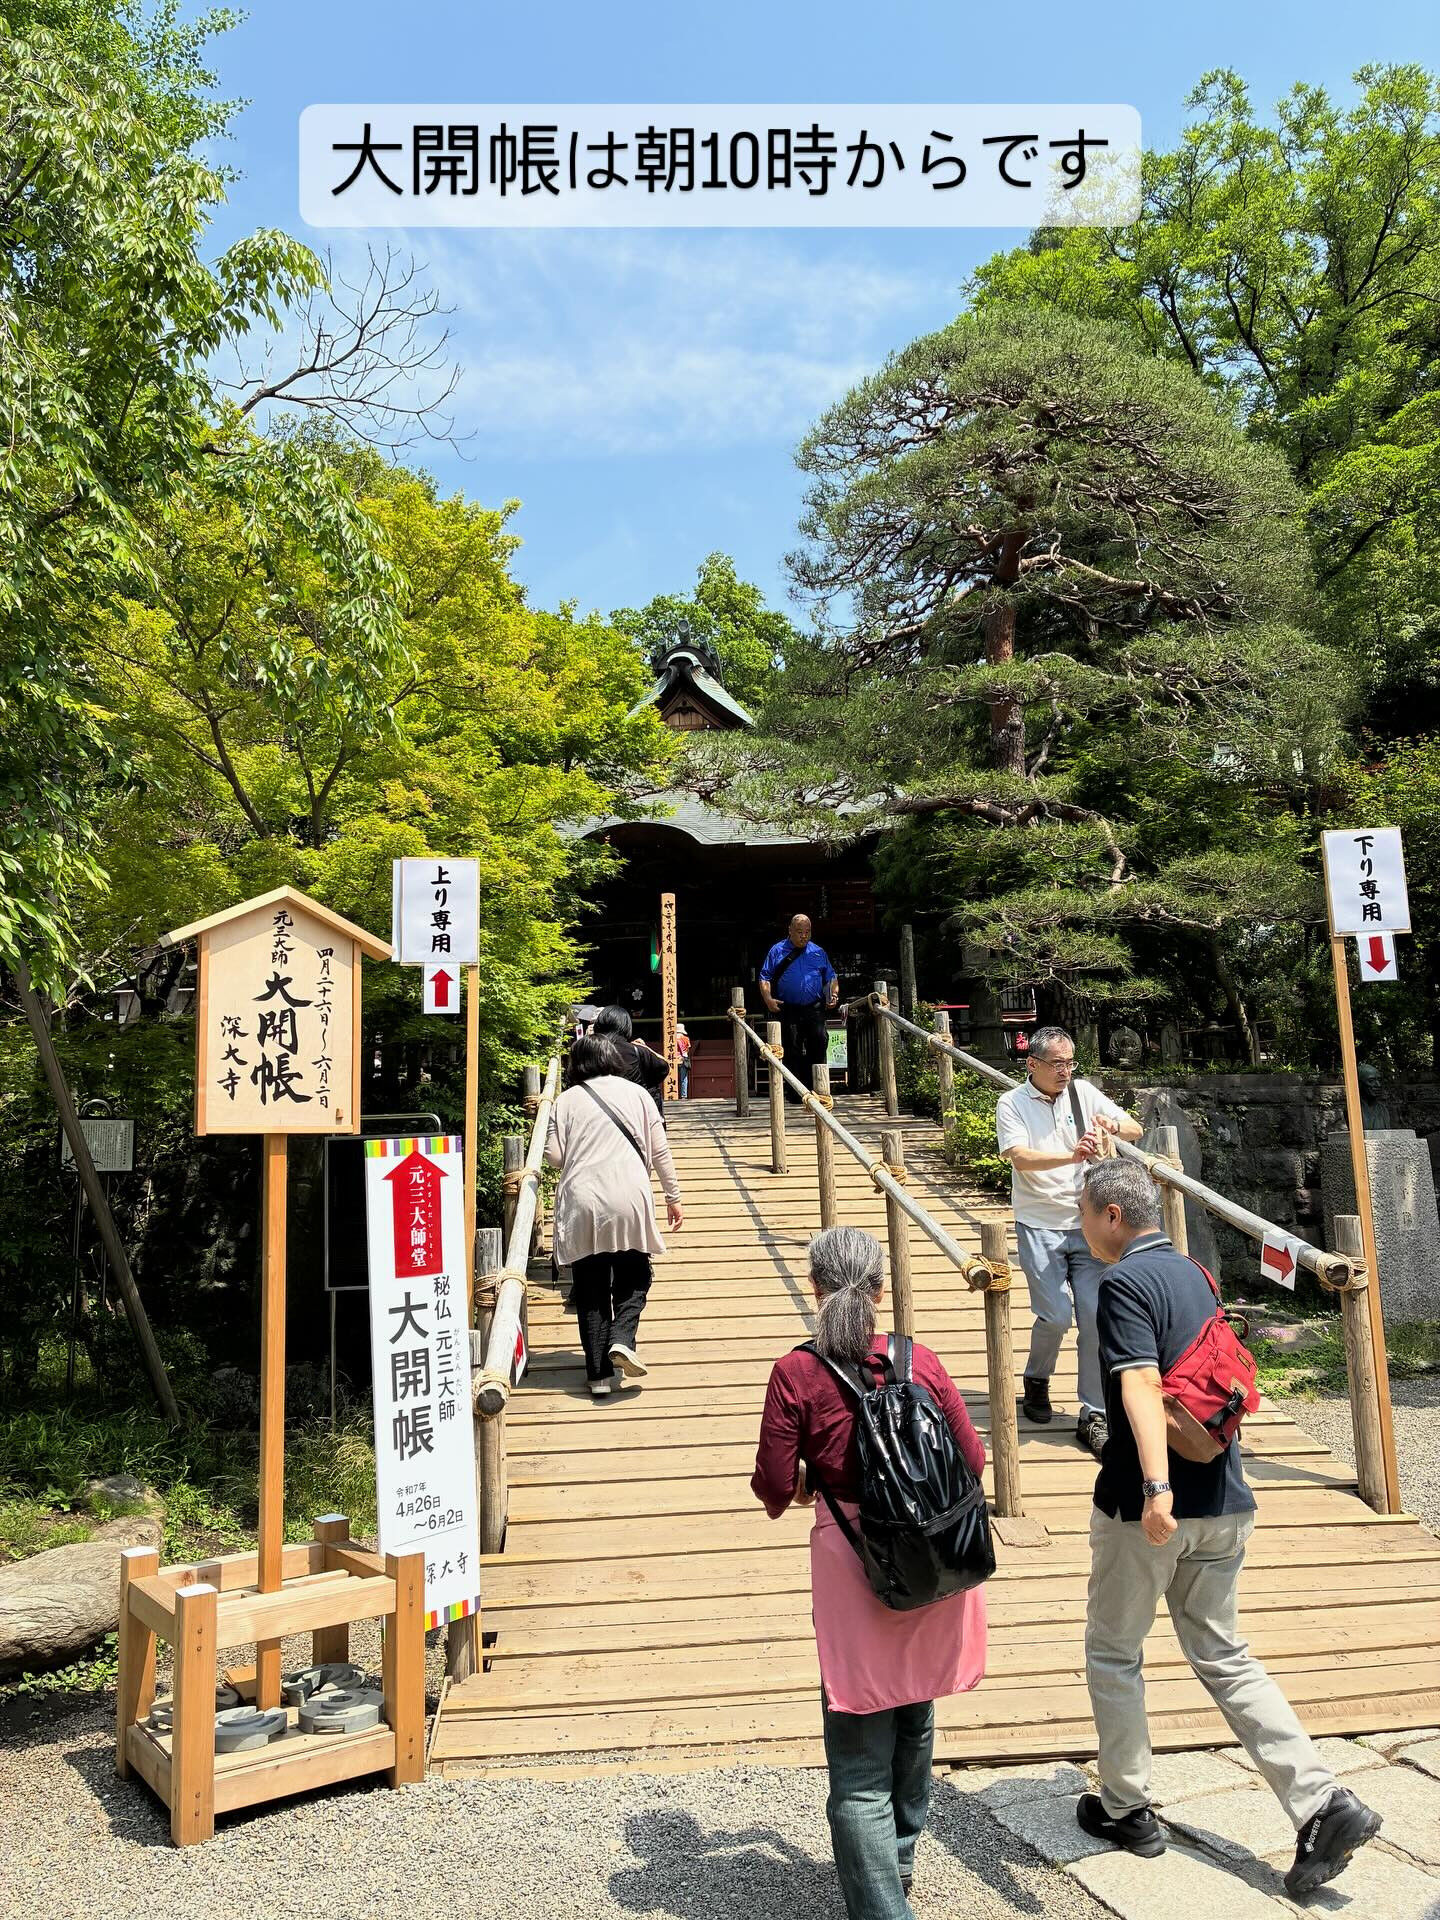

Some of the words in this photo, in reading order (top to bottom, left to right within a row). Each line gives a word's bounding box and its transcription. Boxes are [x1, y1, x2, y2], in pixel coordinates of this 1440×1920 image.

[430, 865, 452, 953] 上り専用
[1353, 835, 1383, 922] 下り専用
[271, 910, 296, 968] 元三大師
[216, 1015, 249, 1101] 深大寺
[250, 970, 314, 1106] 大開帳
[408, 1165, 427, 1268] 元三大師堂
[433, 1275, 452, 1321] 秘仏
[388, 1291, 434, 1461] 大開帳
[436, 1330, 456, 1423] 元三大師
[395, 1482, 427, 1498] 令和7年
[395, 1494, 441, 1518] 4月26日
